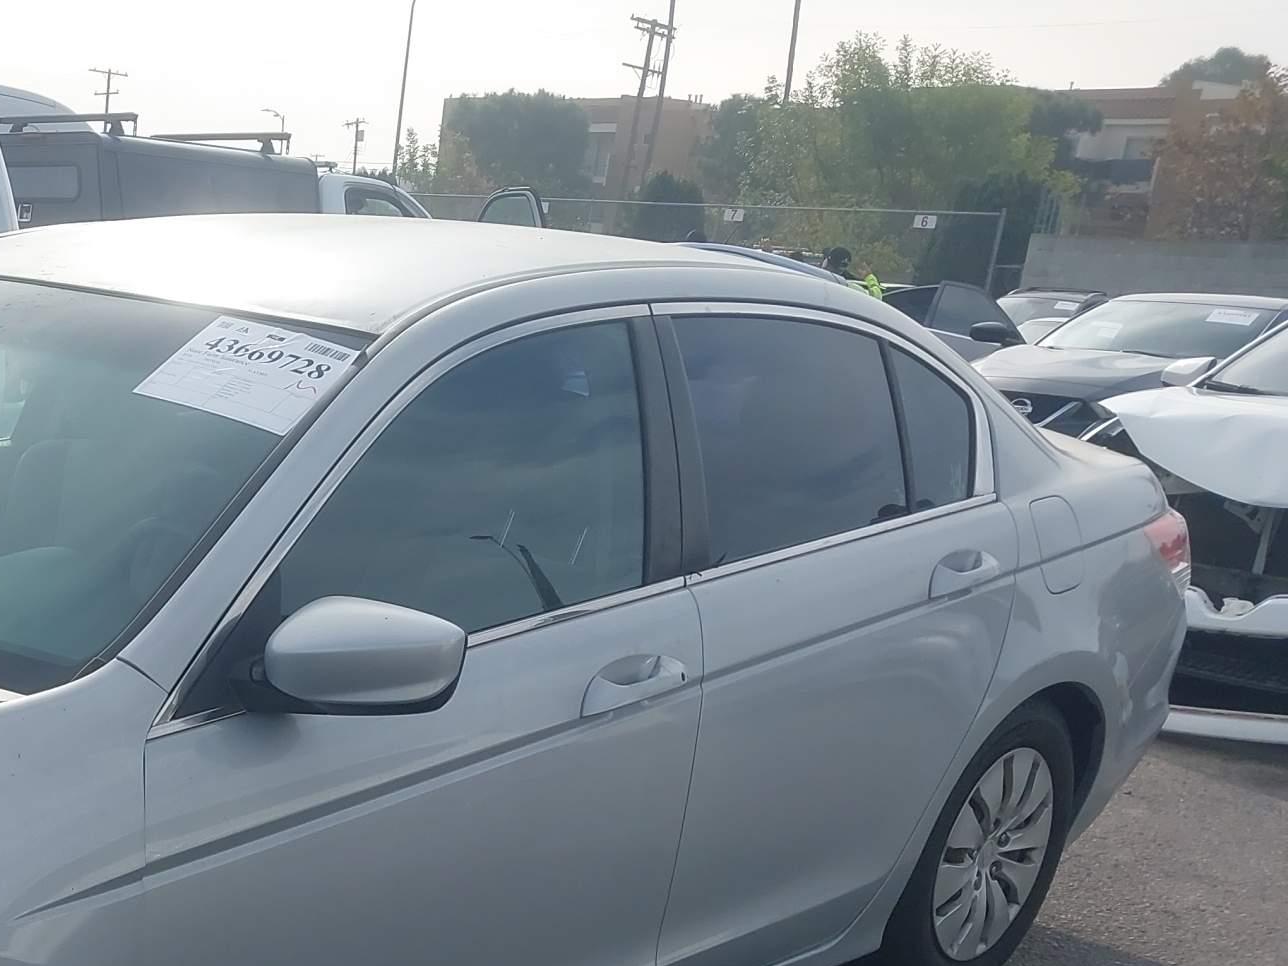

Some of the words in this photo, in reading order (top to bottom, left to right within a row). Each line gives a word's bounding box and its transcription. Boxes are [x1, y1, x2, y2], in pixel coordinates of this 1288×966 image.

[731, 209, 738, 220] 7
[921, 215, 928, 227] 6
[204, 336, 332, 380] 43669728
